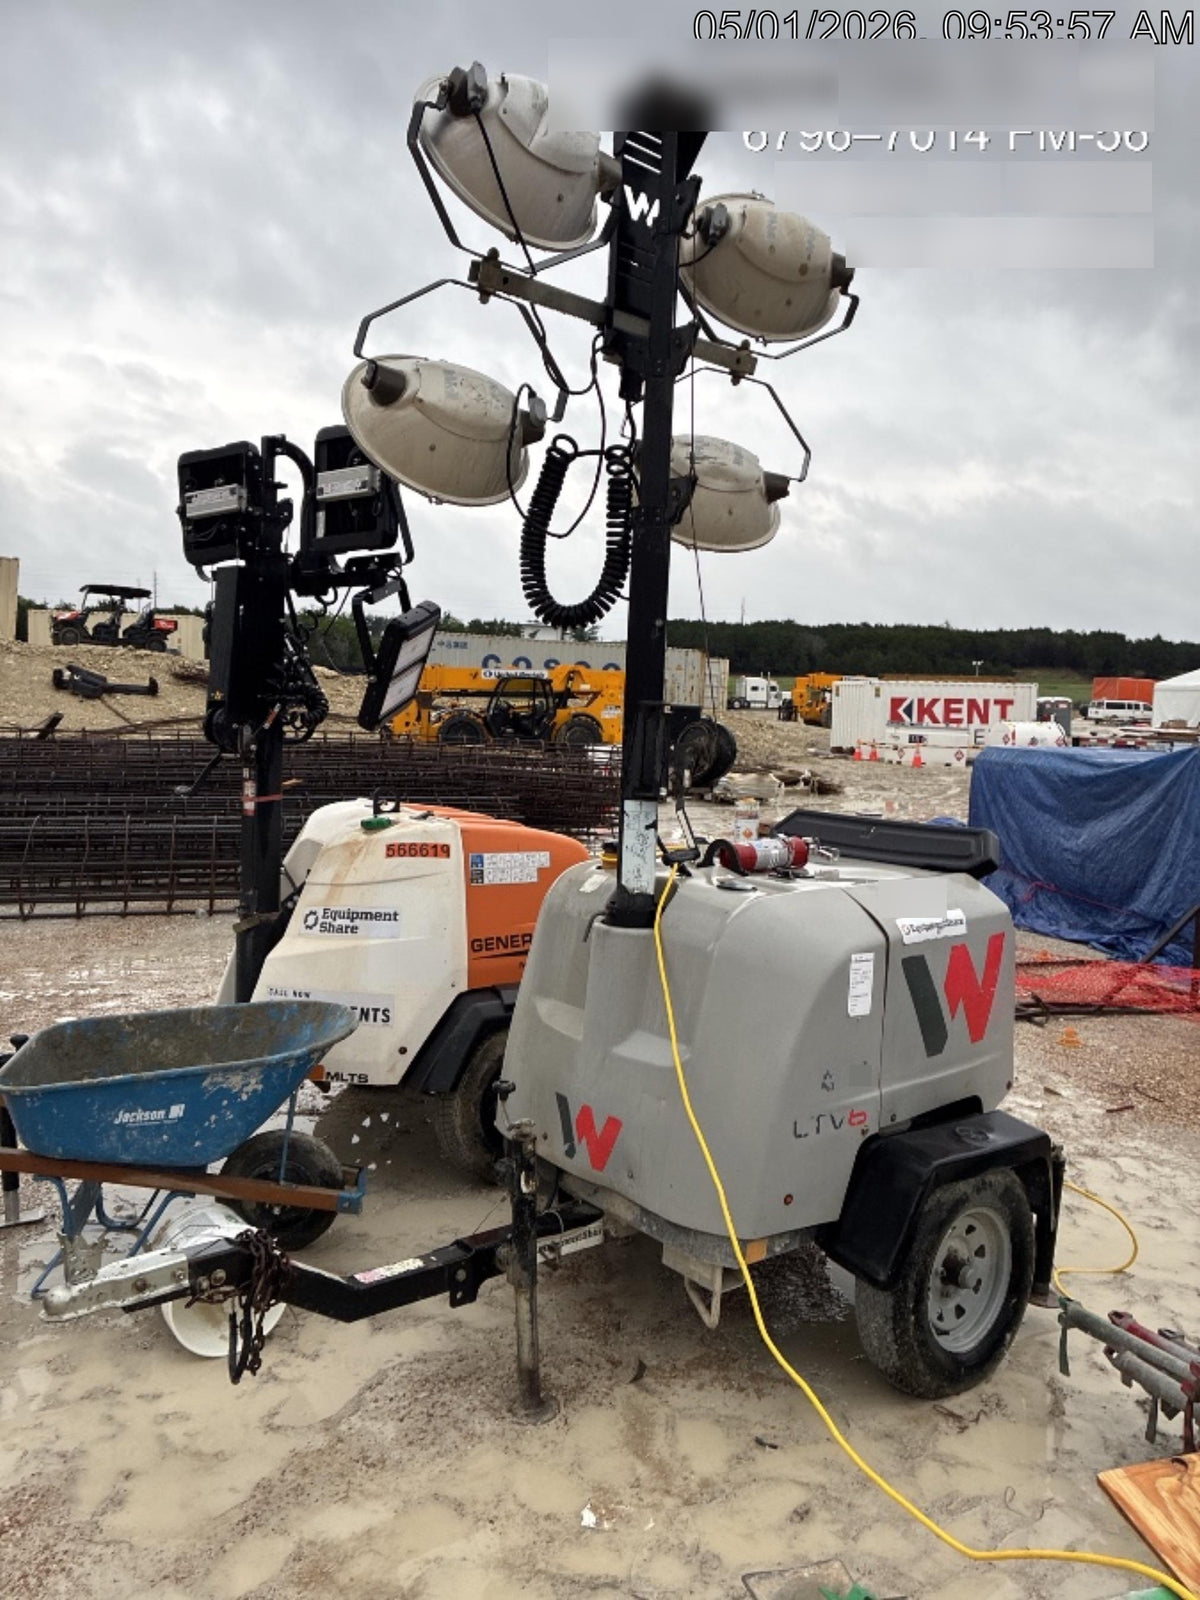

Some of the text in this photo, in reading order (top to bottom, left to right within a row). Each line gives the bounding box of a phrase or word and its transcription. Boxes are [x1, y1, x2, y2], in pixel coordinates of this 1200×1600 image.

[917, 697, 1014, 724] KENT
[386, 844, 450, 857] 566619
[321, 908, 399, 923] Equipment
[319, 921, 359, 934] Share
[326, 1071, 369, 1083] MLTS
[113, 1108, 166, 1124] Jackson
